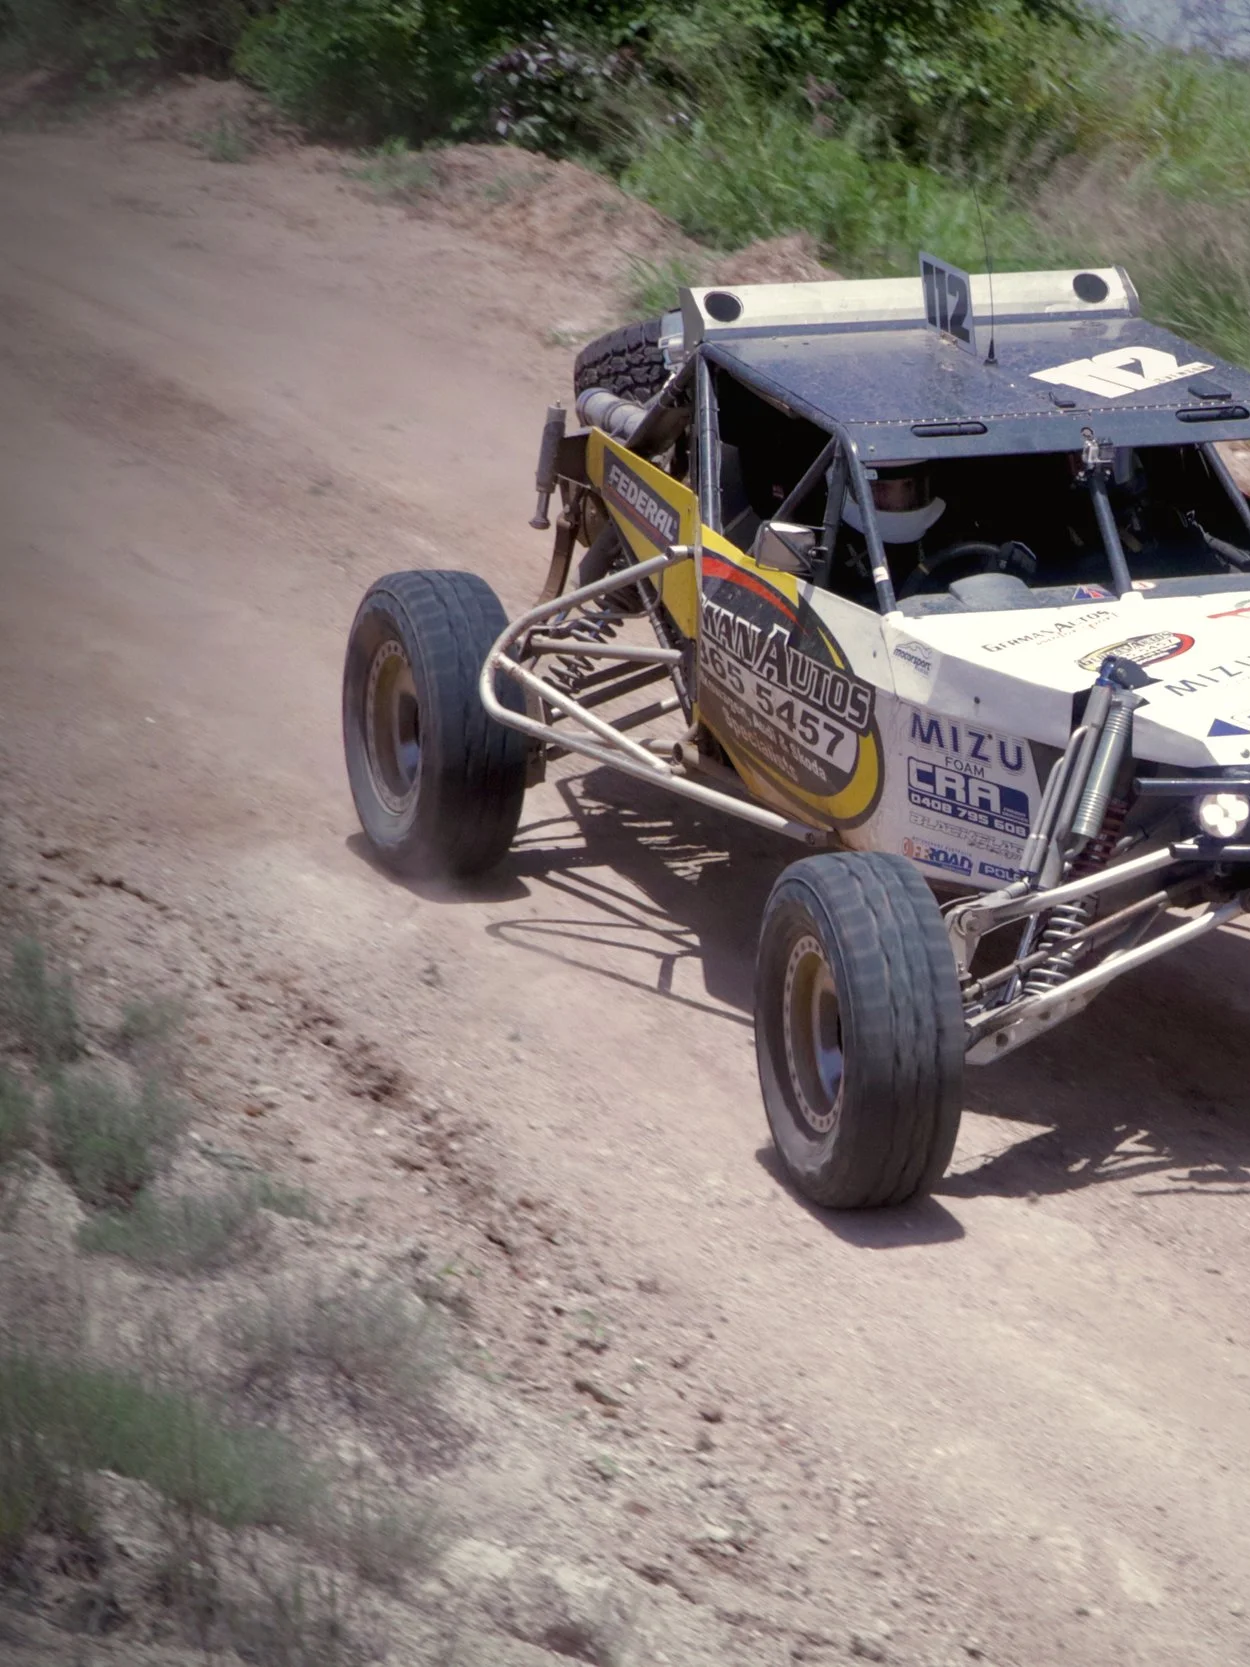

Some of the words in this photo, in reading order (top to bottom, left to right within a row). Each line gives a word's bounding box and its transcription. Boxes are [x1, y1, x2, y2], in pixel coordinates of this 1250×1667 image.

[922, 260, 970, 341] 112
[608, 464, 674, 541] FEDERAL
[756, 683, 845, 757] 5457
[911, 712, 1024, 771] MIZU
[909, 757, 1001, 814] CRA
[945, 756, 985, 778] FOAM
[911, 793, 953, 814] 0408
[958, 808, 989, 825] 795
[994, 820, 1026, 837] 608
